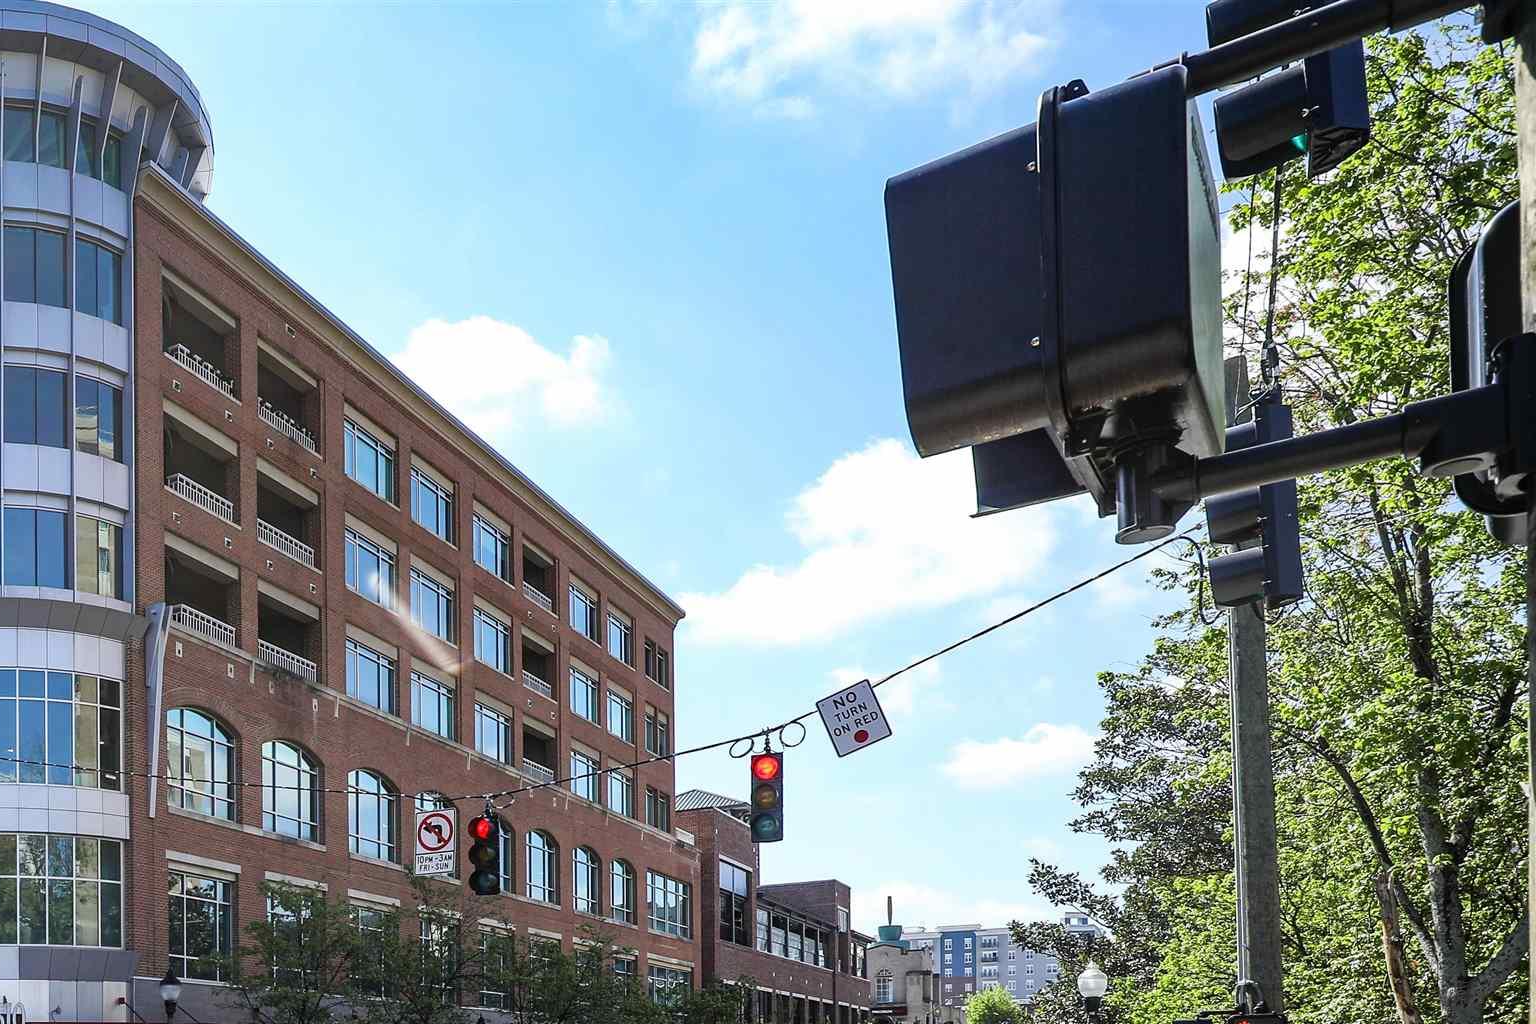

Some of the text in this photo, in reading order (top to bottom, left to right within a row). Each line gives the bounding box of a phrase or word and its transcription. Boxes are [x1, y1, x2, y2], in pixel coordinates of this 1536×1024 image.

[832, 691, 857, 710] NO
[833, 702, 868, 723] TURN
[833, 711, 879, 737] ON RED
